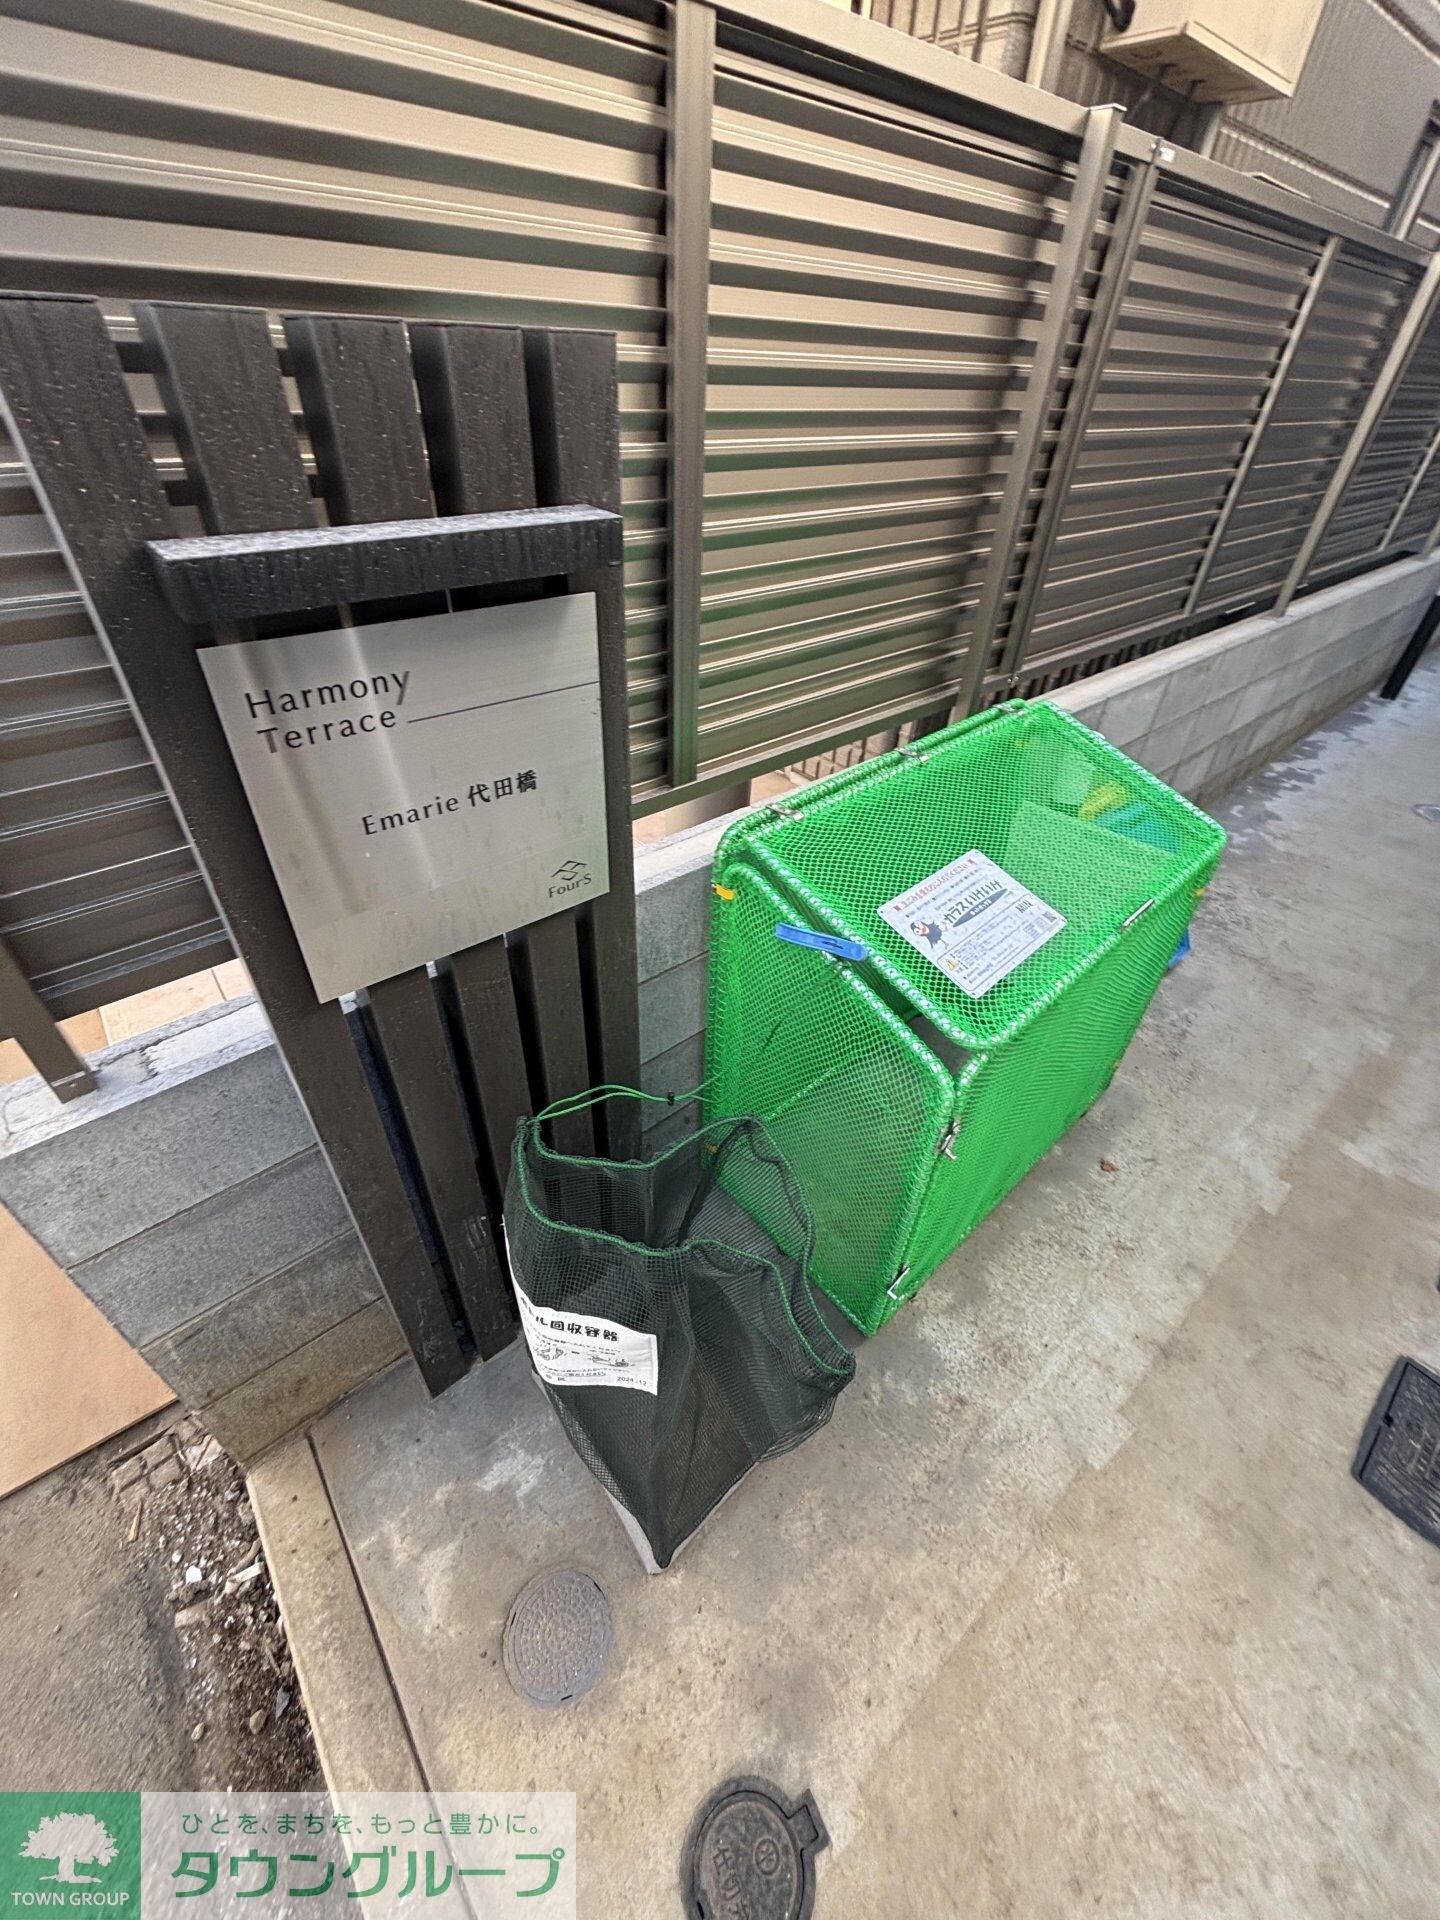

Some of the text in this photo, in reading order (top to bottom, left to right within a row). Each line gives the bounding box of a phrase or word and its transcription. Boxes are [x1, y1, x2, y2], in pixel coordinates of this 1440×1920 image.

[244, 671, 410, 718] Harmony
[257, 710, 396, 753] Terrace
[362, 770, 538, 835] Emarie 代田橋
[548, 873, 592, 899] FourS
[943, 880, 1003, 925] カラスいけいけ
